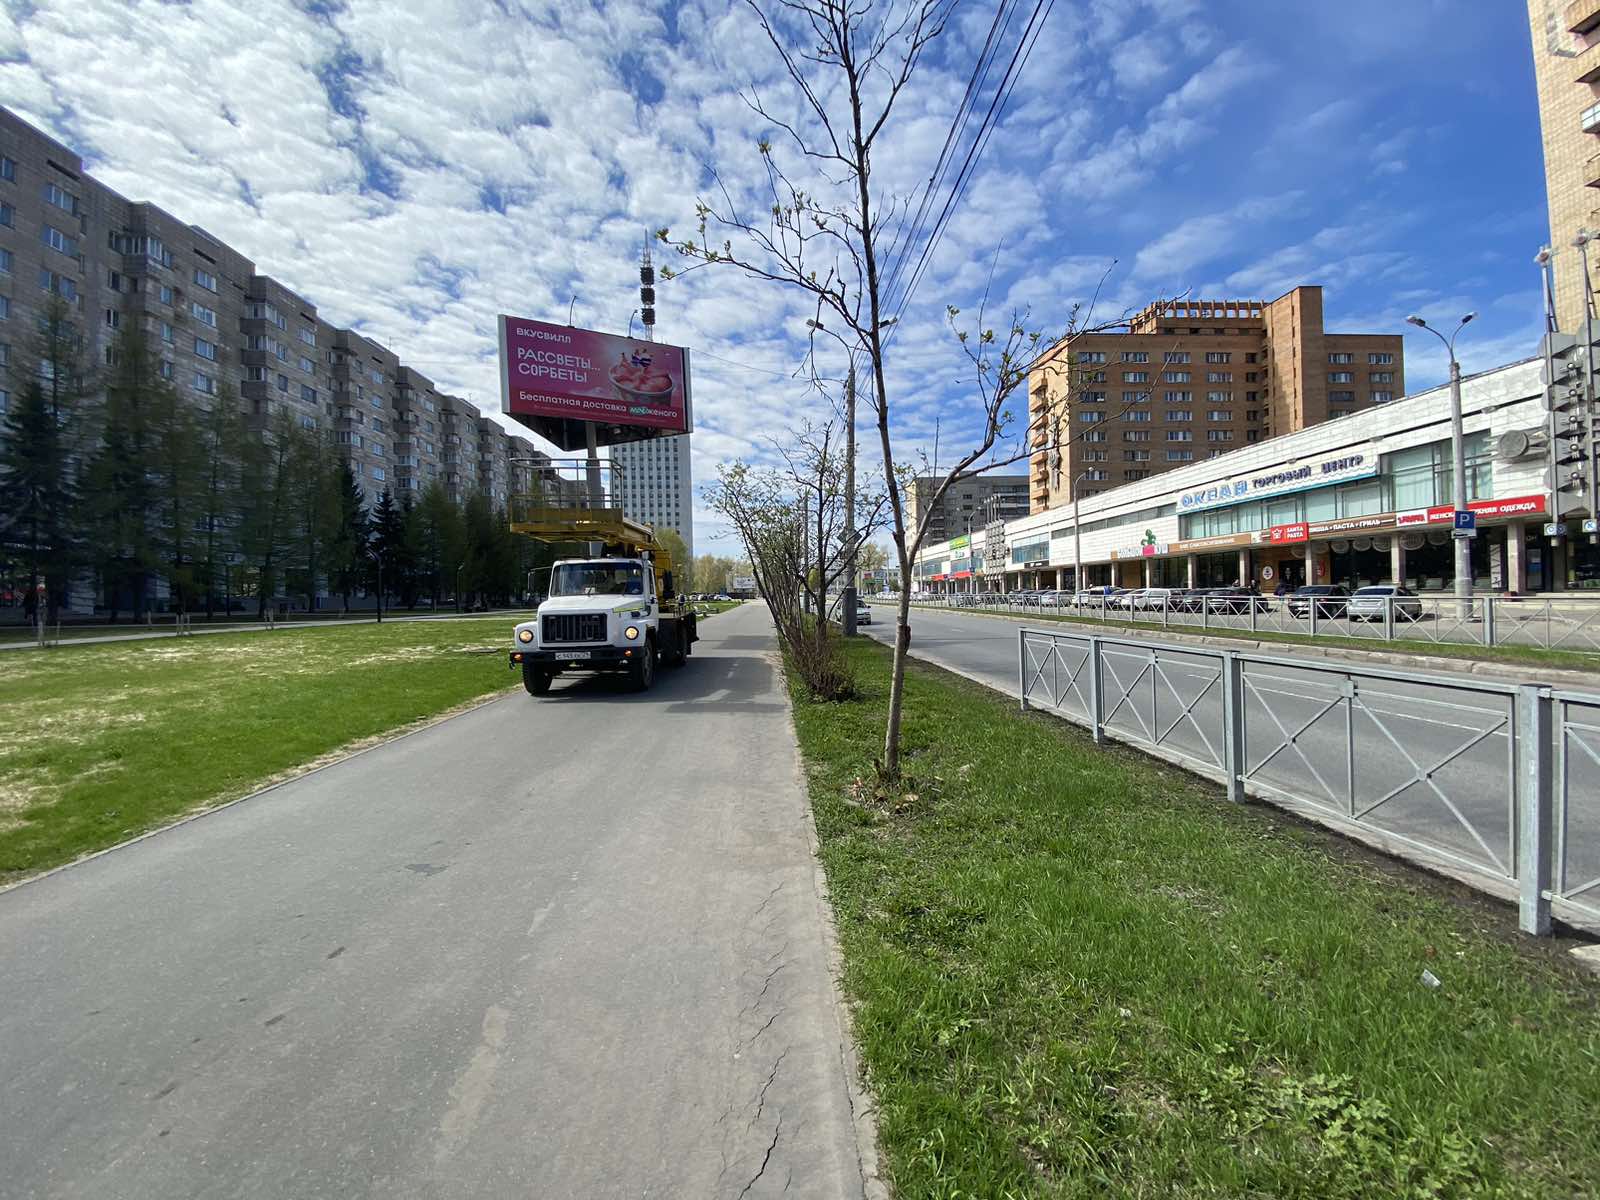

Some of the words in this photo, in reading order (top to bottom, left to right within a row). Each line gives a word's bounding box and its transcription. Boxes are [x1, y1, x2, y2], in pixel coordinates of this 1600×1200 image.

[516, 327, 571, 343] ВКУСВИЛЛ
[518, 362, 587, 383] СОРБЕТЫ
[519, 391, 581, 407] Бесплатная
[583, 400, 627, 412] доставка
[1182, 480, 1248, 507] ОКЕАН
[1252, 465, 1312, 489] ТОРГОВЫЙ
[1321, 455, 1364, 474] ЦЕНТР
[1500, 502, 1537, 513] ОДЕЖДА
[1333, 522, 1354, 530] ПАСТА
[1360, 519, 1381, 528] ГРИЛЬ
[1460, 514, 1470, 526] P
